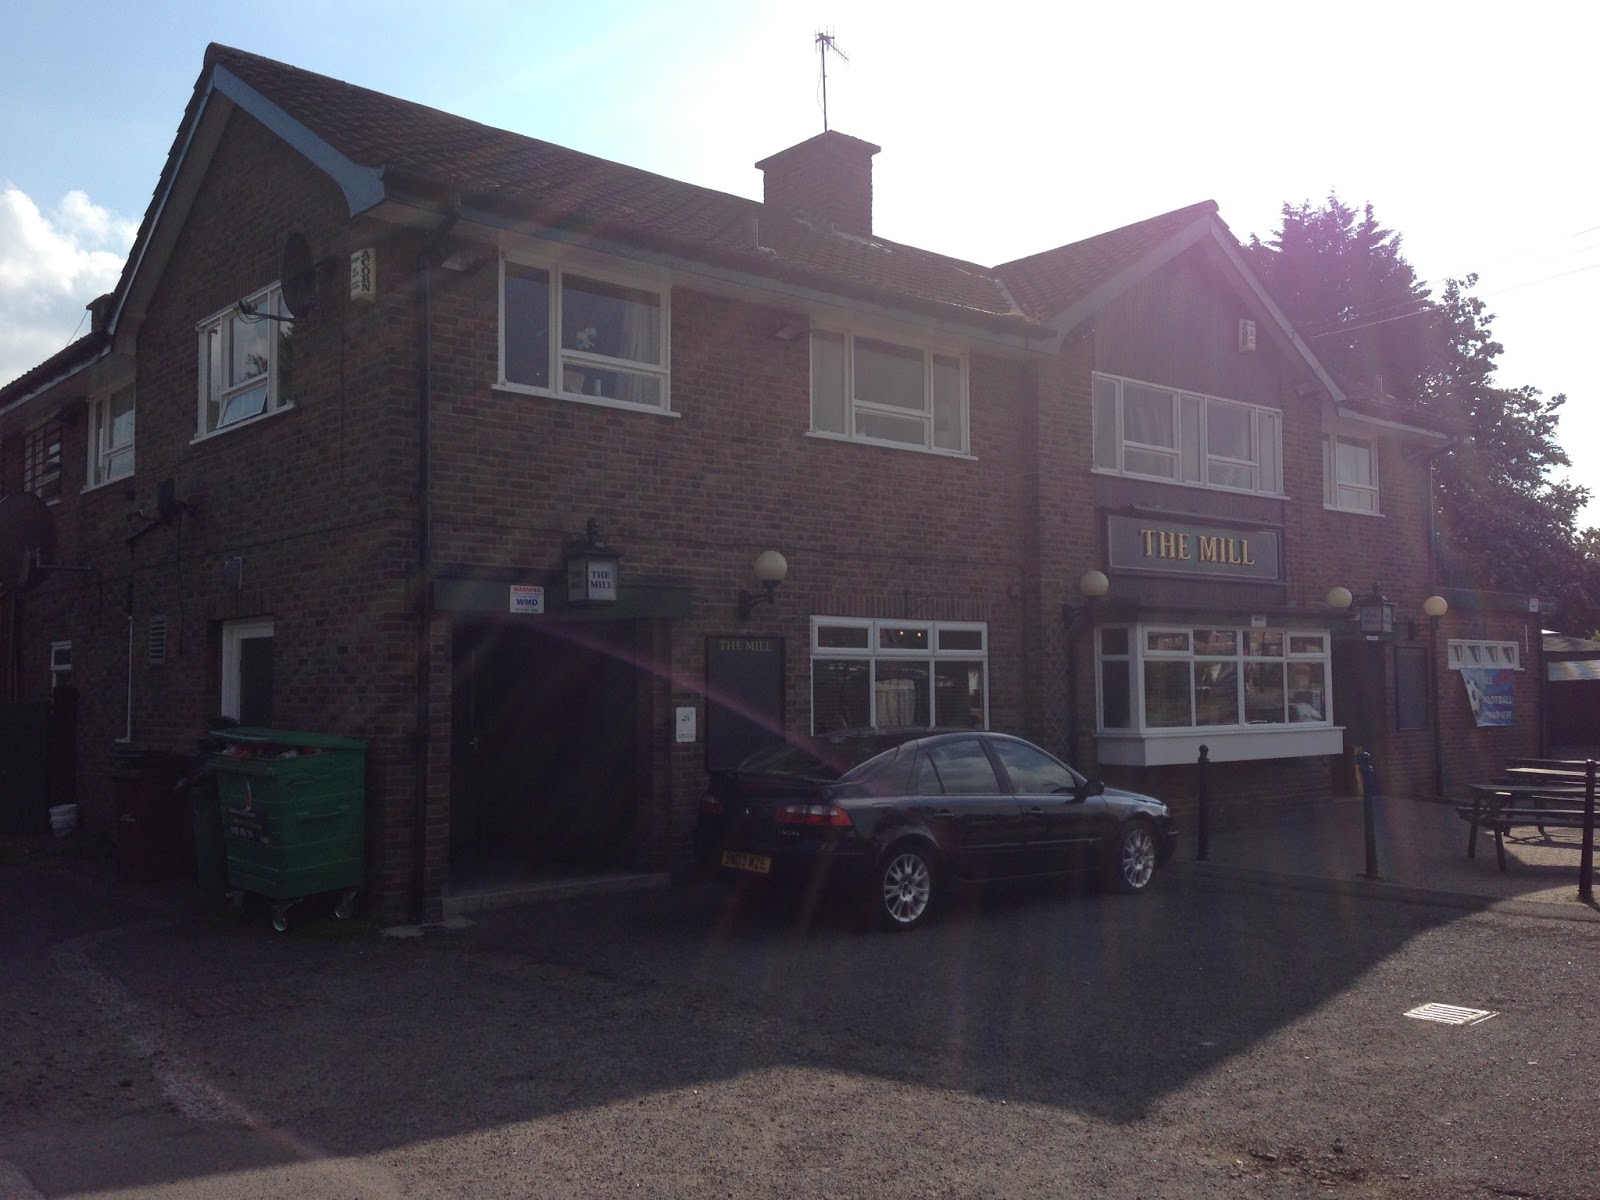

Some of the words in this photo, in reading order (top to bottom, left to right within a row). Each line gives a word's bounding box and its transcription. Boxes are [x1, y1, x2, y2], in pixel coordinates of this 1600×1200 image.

[361, 250, 371, 291] ACORN
[1138, 529, 1191, 560] THE
[1197, 535, 1255, 565] MILL
[591, 571, 610, 579] THE
[590, 580, 612, 589] MILL
[516, 598, 538, 606] WMD
[720, 640, 743, 651] THE
[746, 640, 773, 652] MILL
